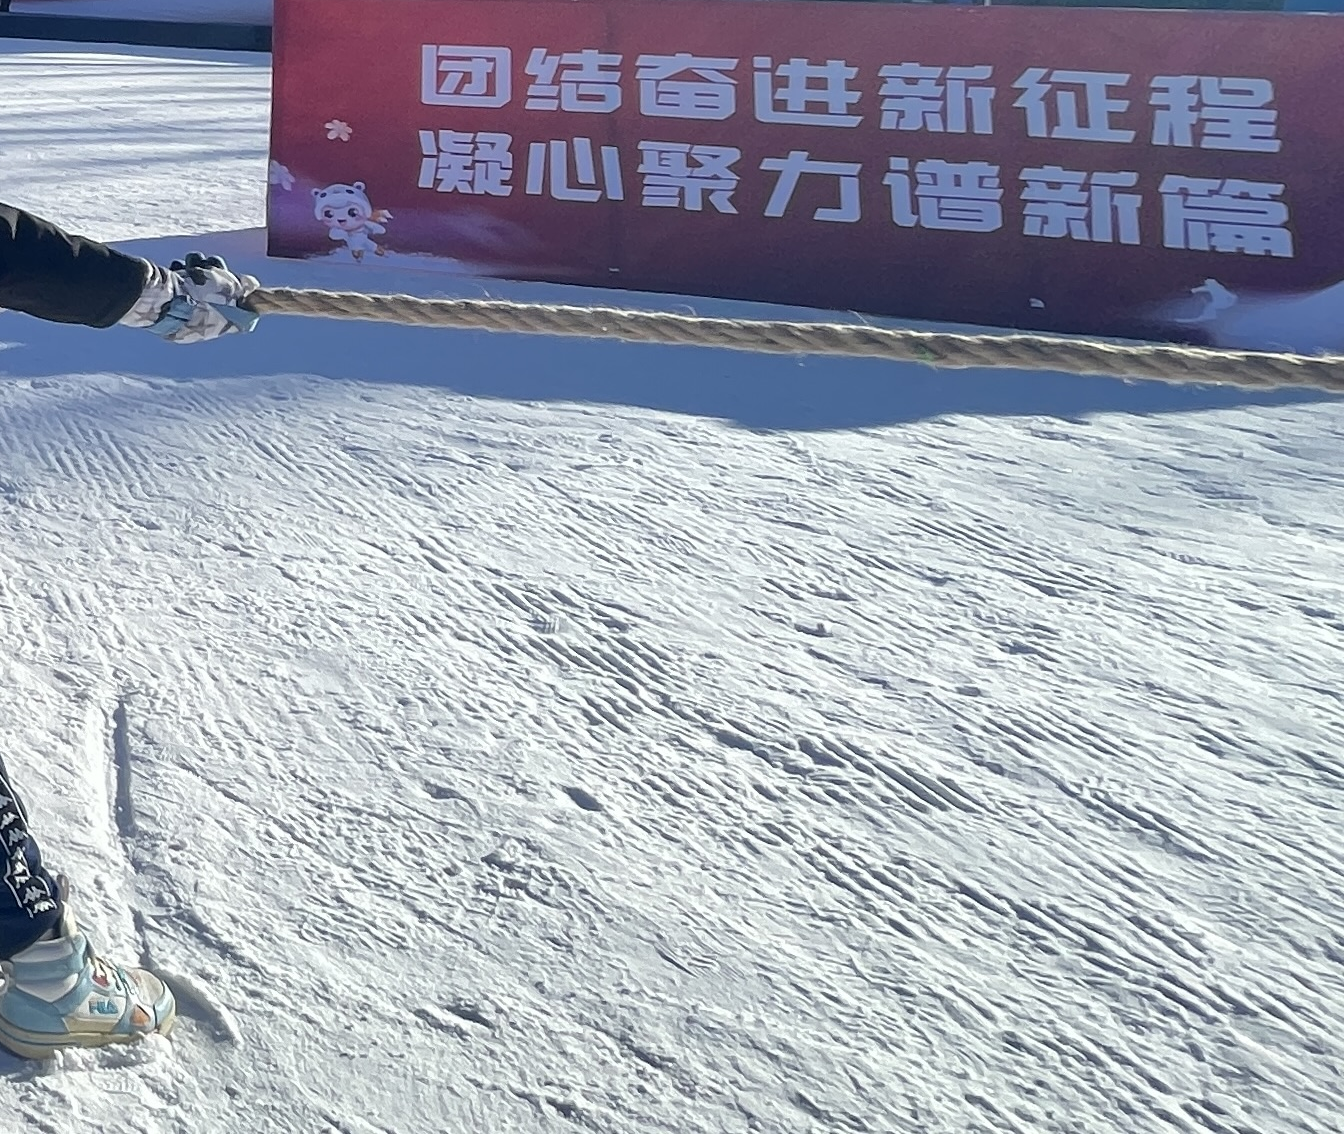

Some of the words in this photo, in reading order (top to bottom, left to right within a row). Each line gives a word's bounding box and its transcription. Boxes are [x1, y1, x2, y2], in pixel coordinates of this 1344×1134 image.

[420, 43, 1282, 153] 团结奋进新征程
[417, 129, 1294, 258] 凝心聚力谱新篇
